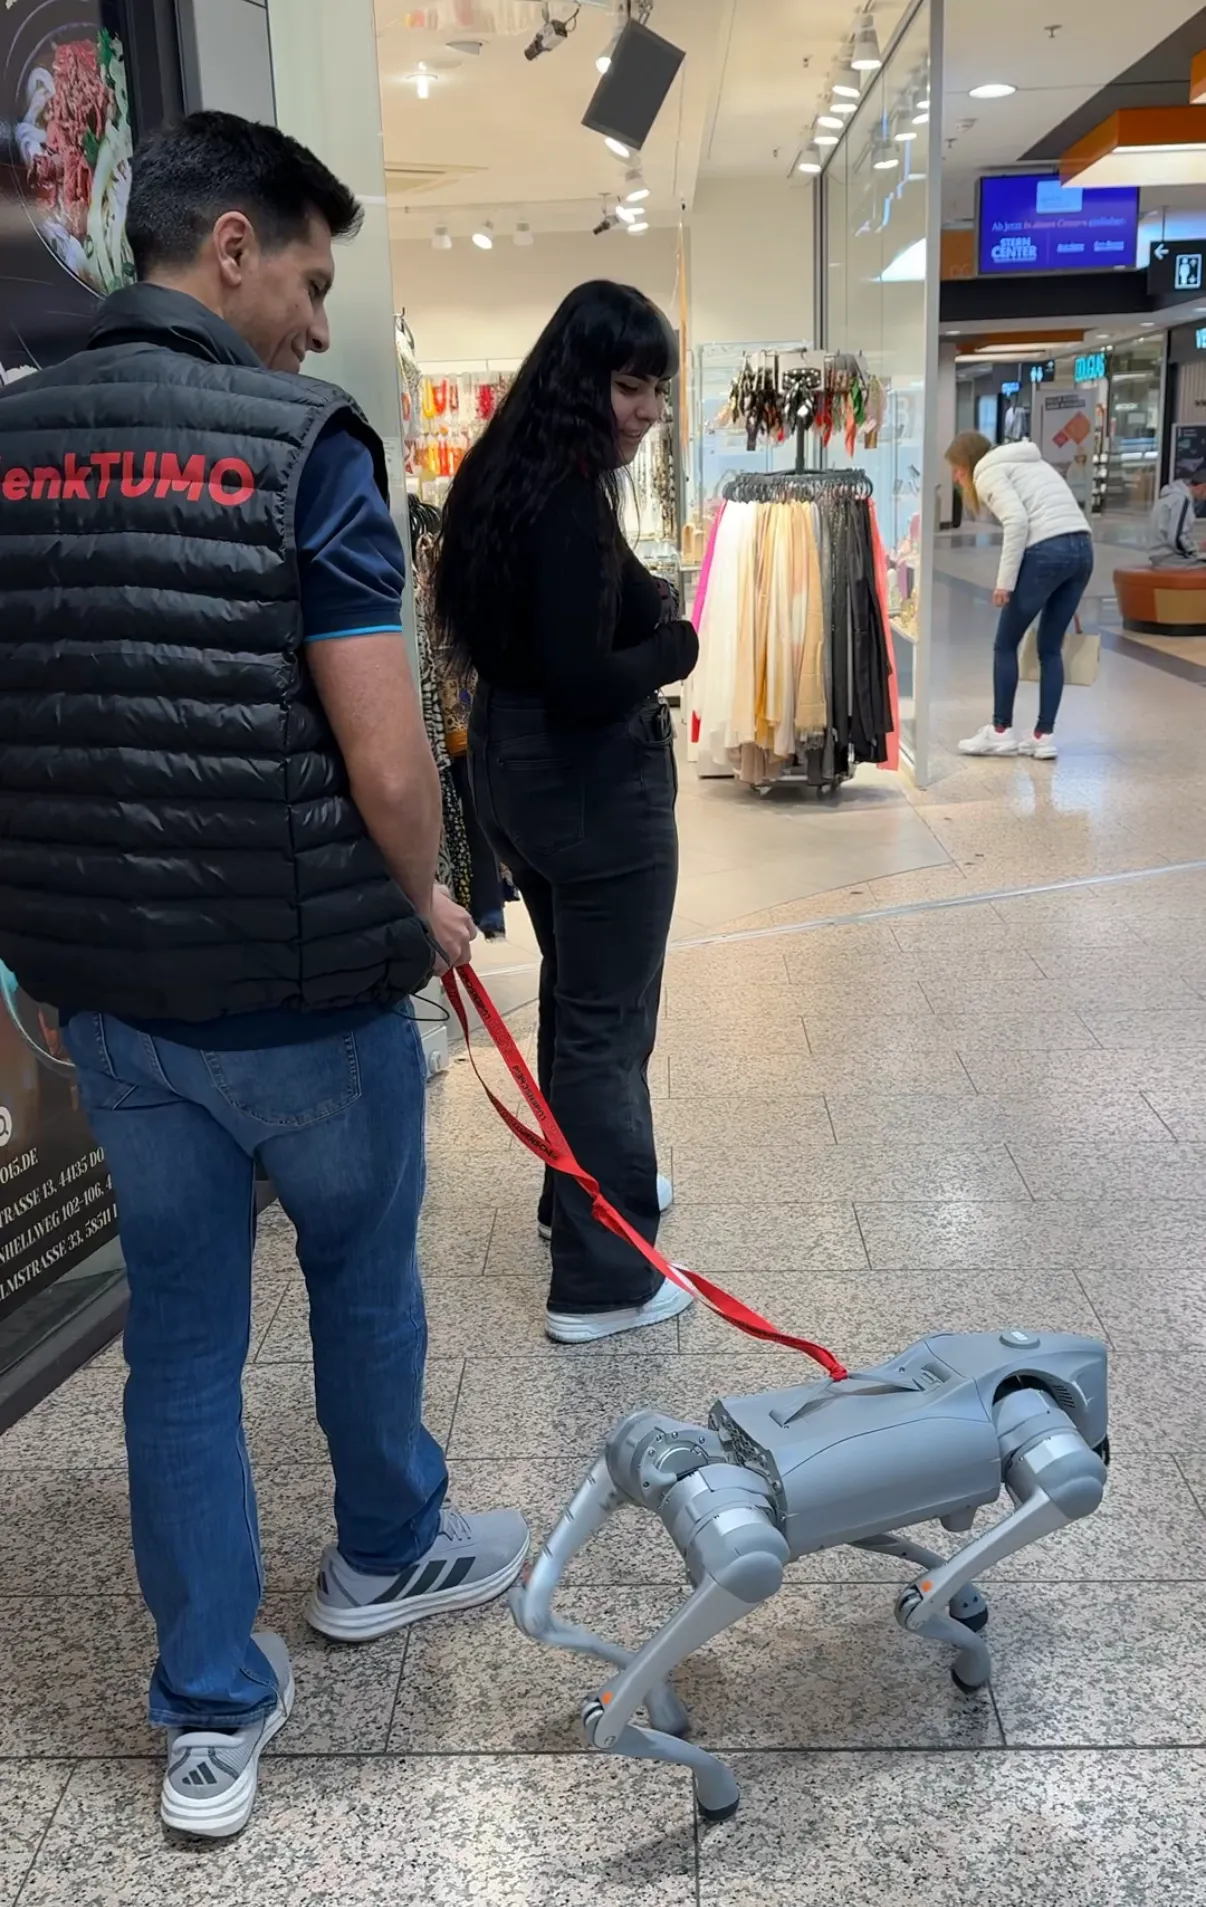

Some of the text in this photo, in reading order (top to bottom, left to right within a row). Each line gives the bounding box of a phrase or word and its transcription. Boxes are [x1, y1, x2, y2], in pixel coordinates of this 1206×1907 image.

[991, 245, 1037, 258] CENTER
[1000, 237, 1031, 247] STERN
[0, 450, 255, 507] enkTUMO
[59, 1155, 88, 1187] 44135
